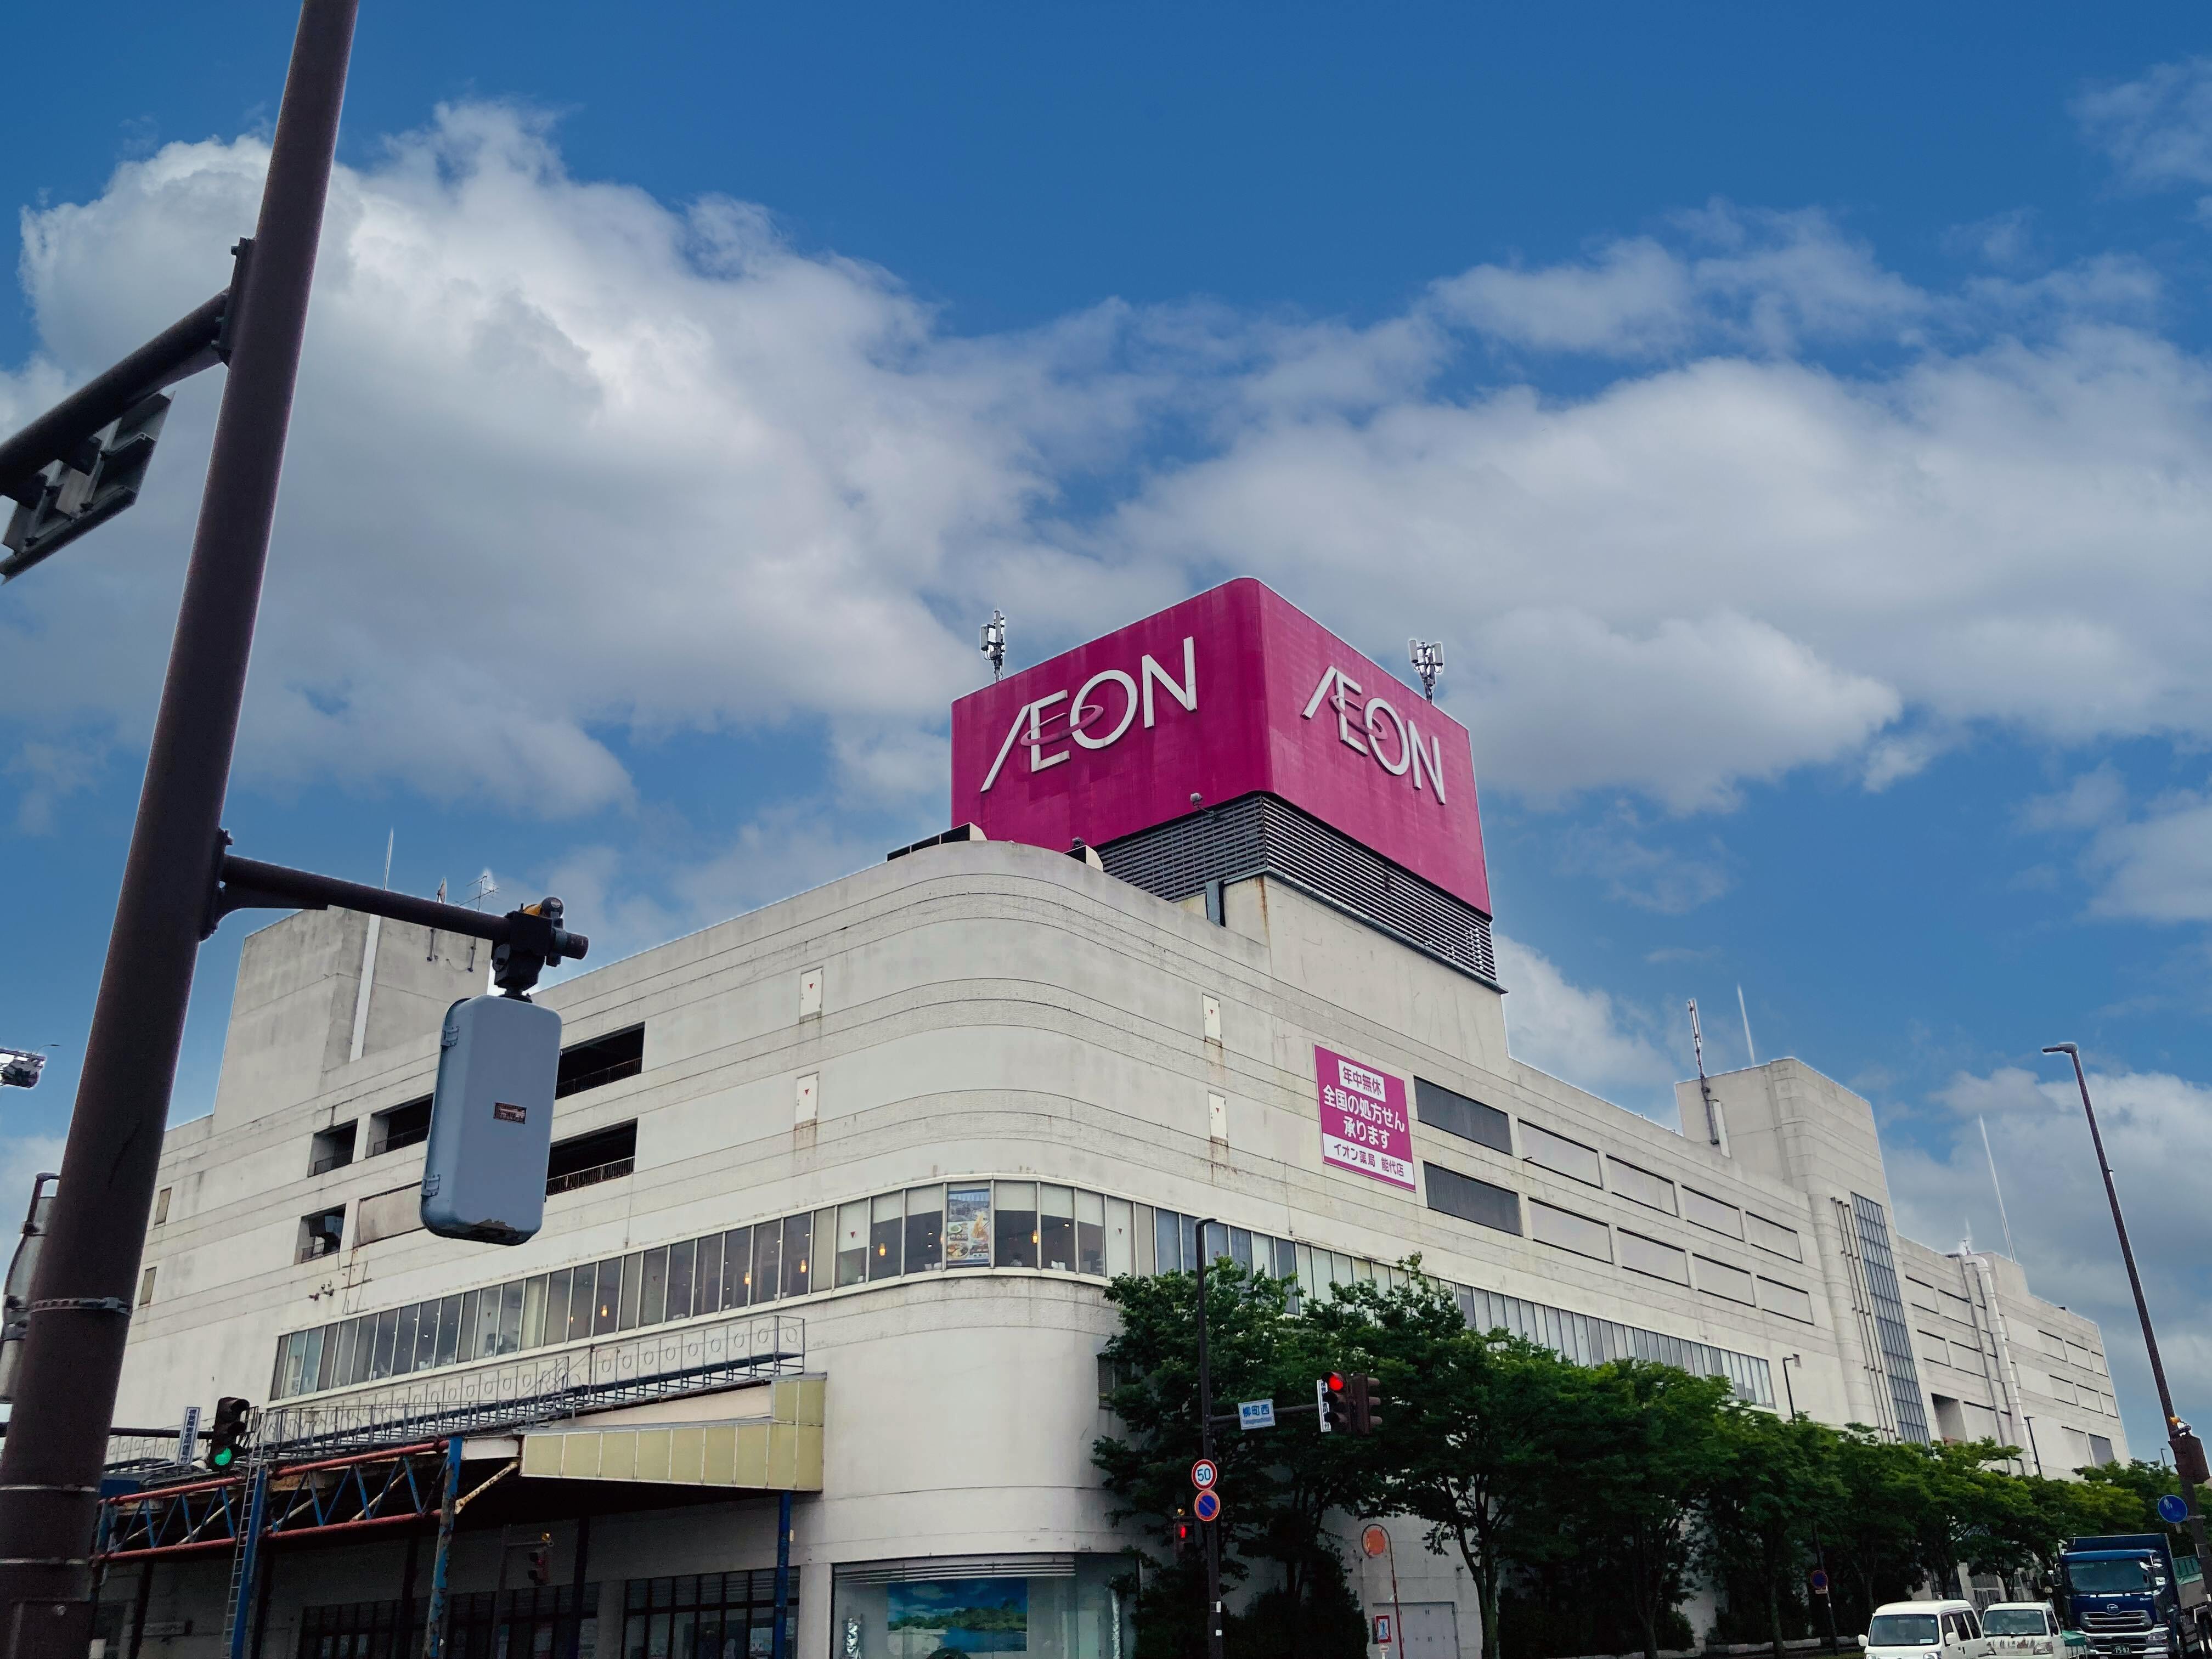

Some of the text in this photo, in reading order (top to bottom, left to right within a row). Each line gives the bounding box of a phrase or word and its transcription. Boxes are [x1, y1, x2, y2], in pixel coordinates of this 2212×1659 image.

[1342, 1066, 1382, 1096] 年中無休
[1323, 1084, 1405, 1132] 全国の処方せん
[1343, 1115, 1390, 1149] 承ります
[1334, 1143, 1404, 1177] イオン薬局 能代店
[1197, 1468, 1211, 1481] 50
